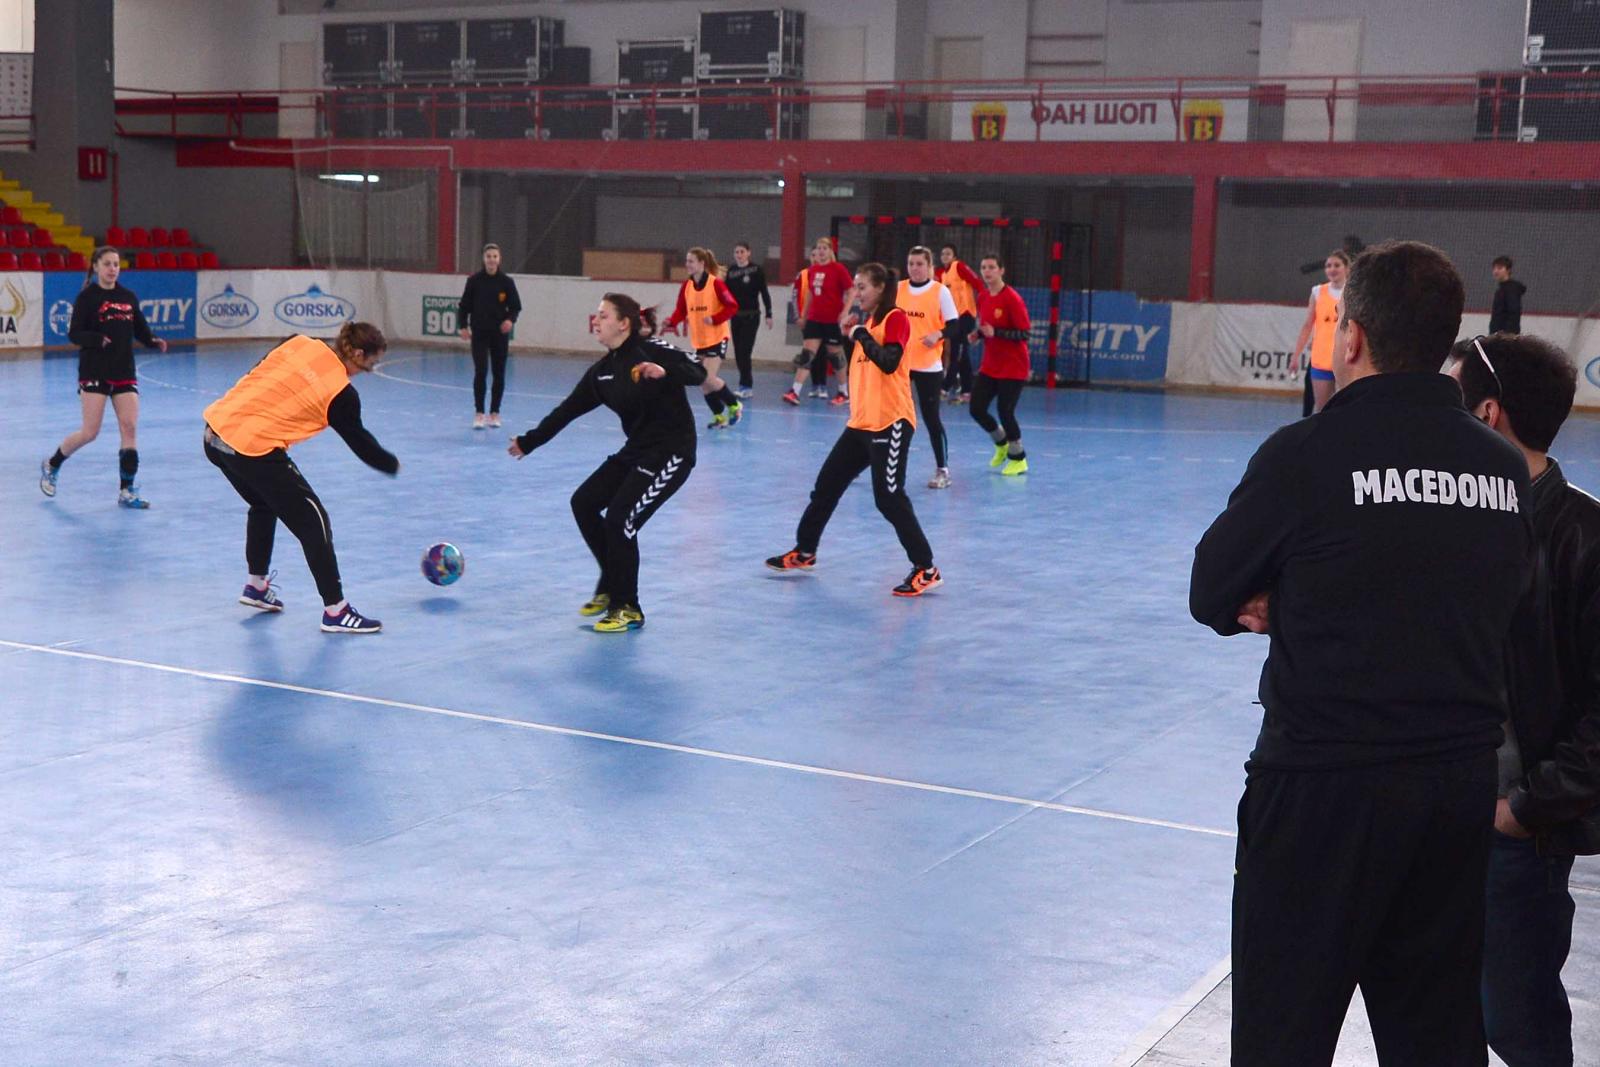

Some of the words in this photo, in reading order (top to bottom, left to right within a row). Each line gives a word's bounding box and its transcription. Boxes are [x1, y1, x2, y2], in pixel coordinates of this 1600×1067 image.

[1094, 102, 1157, 125] ШОП
[139, 298, 193, 323] CITY
[208, 303, 250, 317] GORSKA
[283, 303, 345, 317] GORSKA
[1029, 320, 1161, 353] ETCITY
[1351, 468, 1519, 513] MACEDONIA
